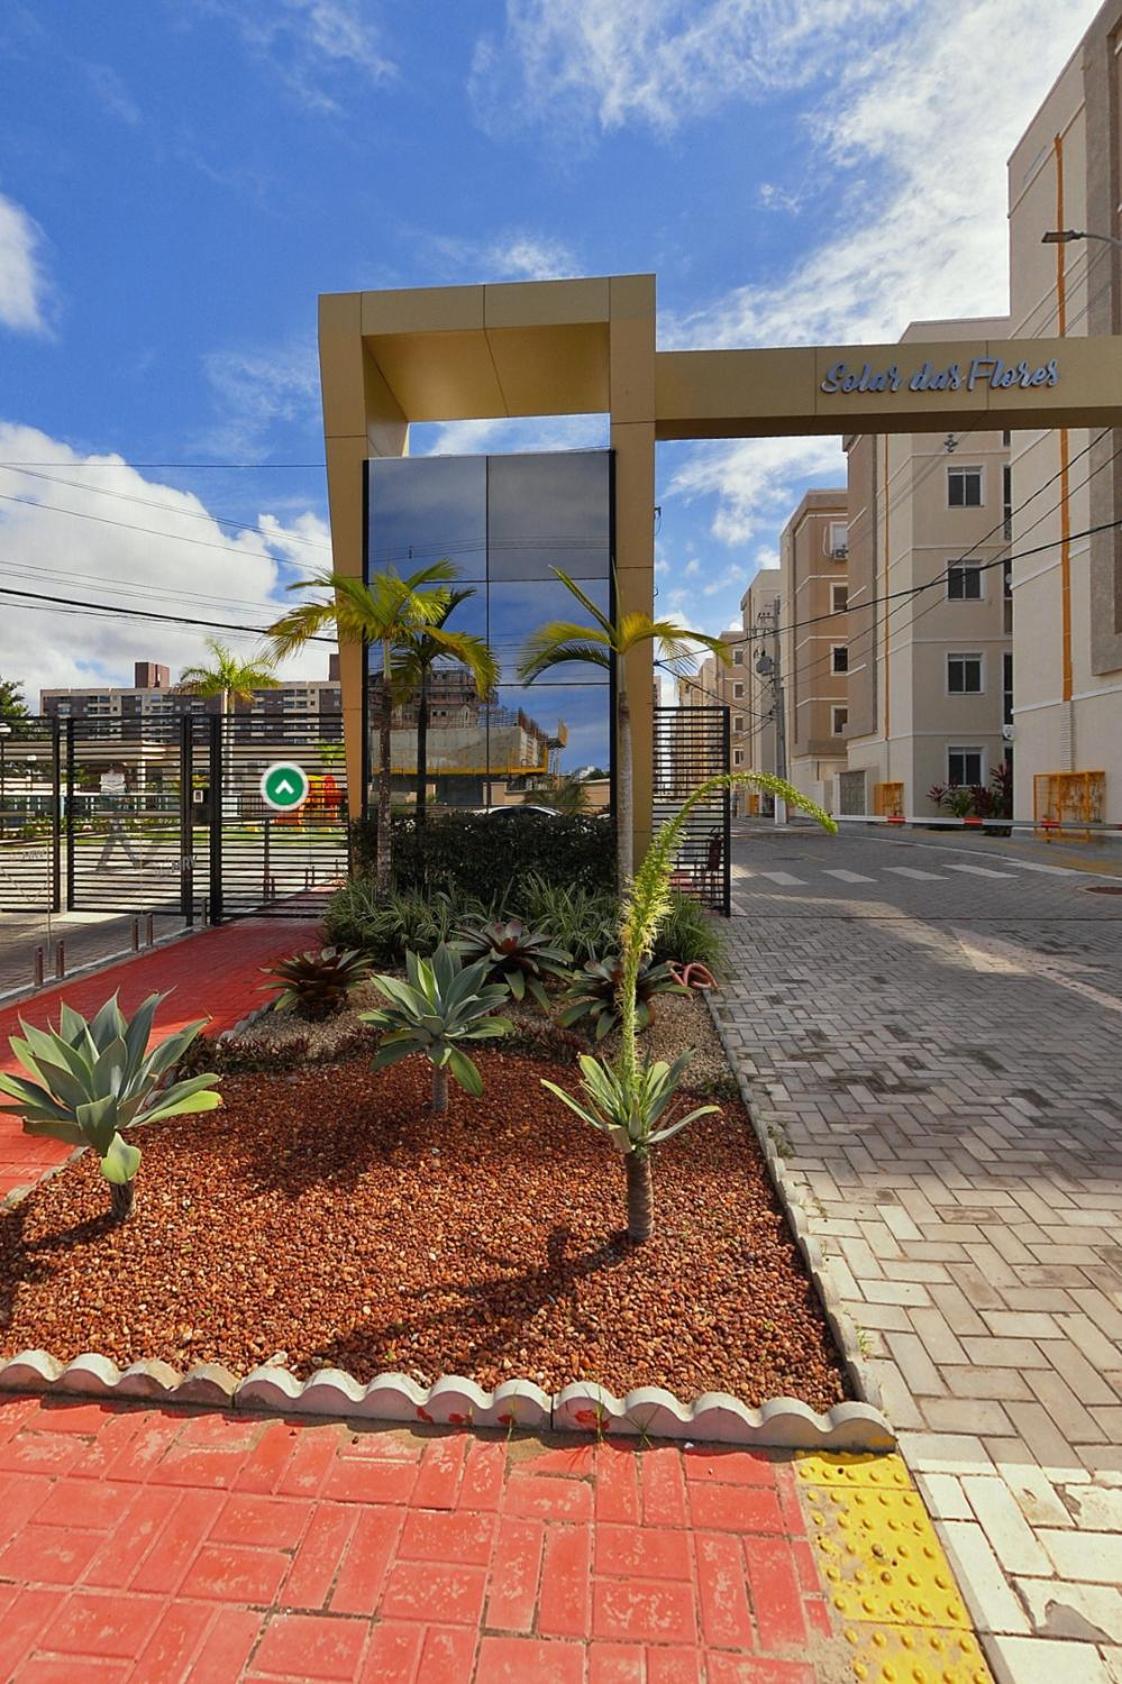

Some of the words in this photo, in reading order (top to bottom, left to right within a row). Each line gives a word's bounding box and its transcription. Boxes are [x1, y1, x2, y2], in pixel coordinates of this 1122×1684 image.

[821, 362, 901, 393] Solar
[908, 360, 960, 391] das
[966, 356, 1060, 391] Flores
